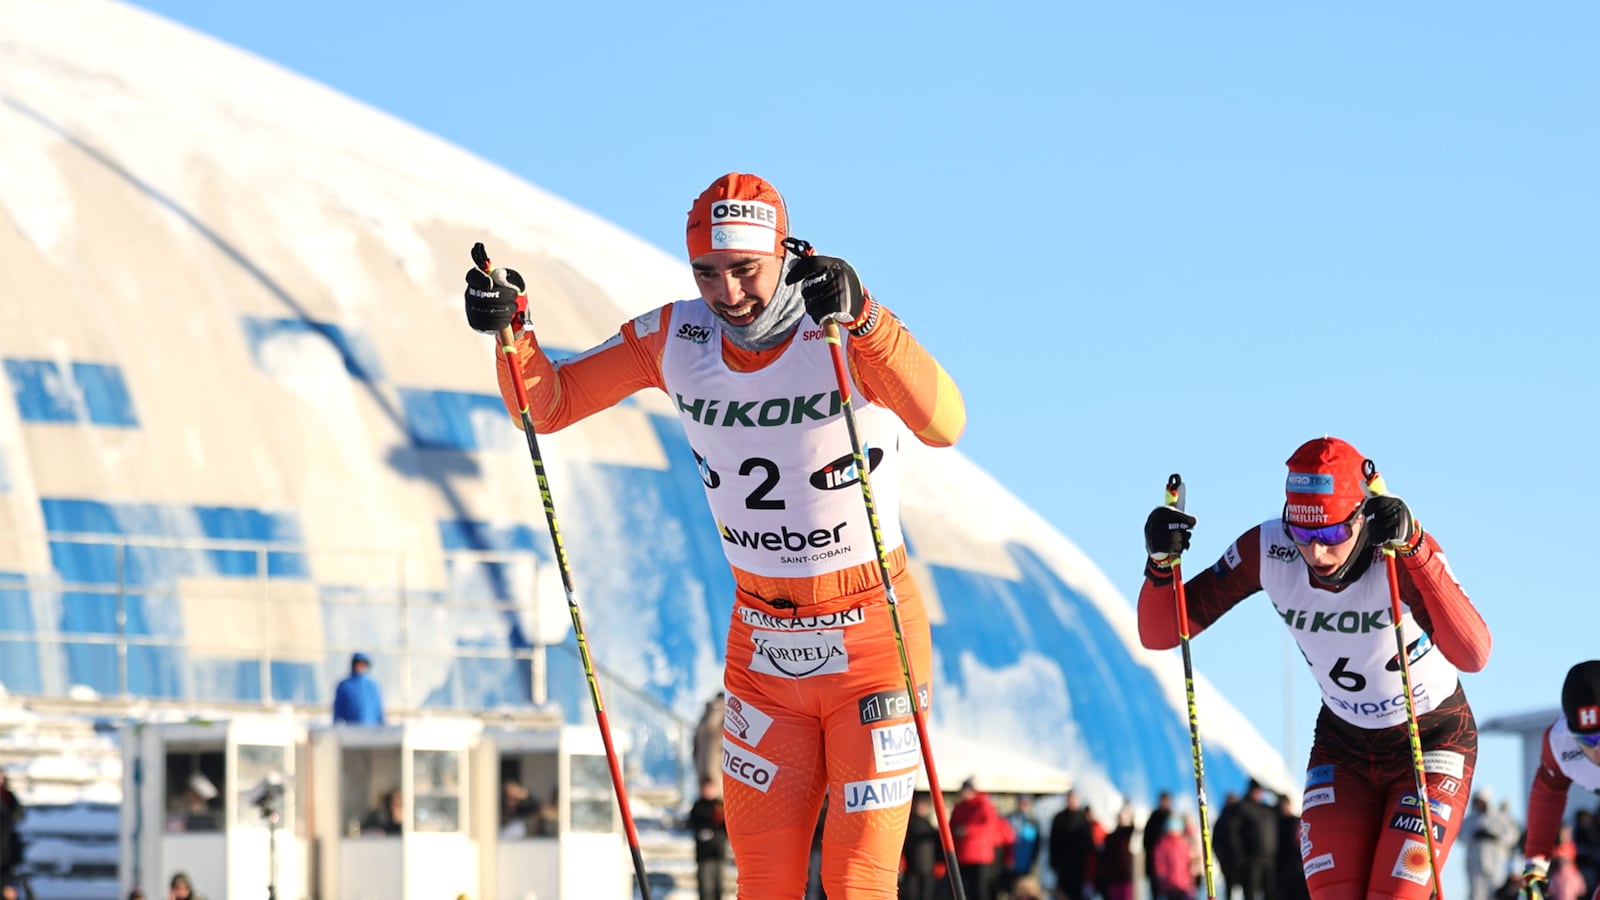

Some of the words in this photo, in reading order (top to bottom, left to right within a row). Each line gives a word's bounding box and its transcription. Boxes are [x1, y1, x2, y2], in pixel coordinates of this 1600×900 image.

[713, 205, 775, 224] OSHEE
[678, 323, 711, 341] SGN
[738, 457, 786, 511] 2
[727, 522, 848, 552] weber
[780, 545, 852, 564] SAINT-GOBAIN
[1268, 544, 1296, 558] SGN
[753, 638, 845, 662] KORPELA
[1329, 657, 1367, 692] 6
[1581, 710, 1597, 726] H
